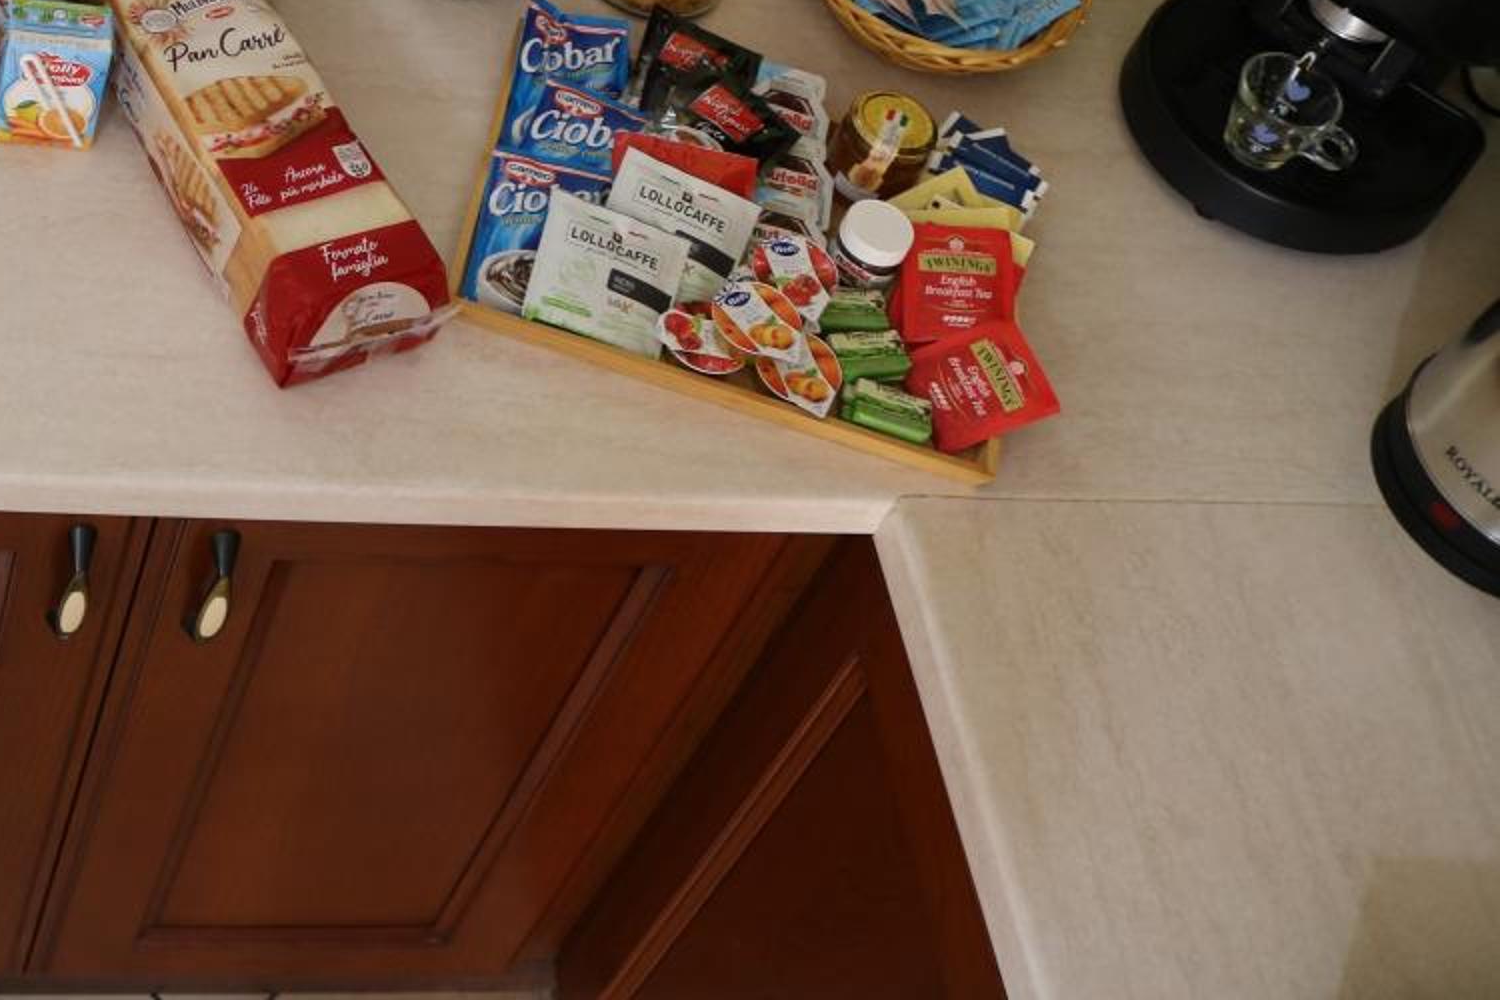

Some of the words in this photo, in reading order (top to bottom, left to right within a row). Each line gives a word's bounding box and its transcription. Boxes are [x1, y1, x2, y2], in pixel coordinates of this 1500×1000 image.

[164, 41, 218, 72] Pan
[531, 109, 615, 149] Ciob
[771, 167, 818, 191] utella
[320, 237, 378, 264] Formato
[925, 256, 994, 272] TWININGS
[332, 253, 388, 282] famiglia
